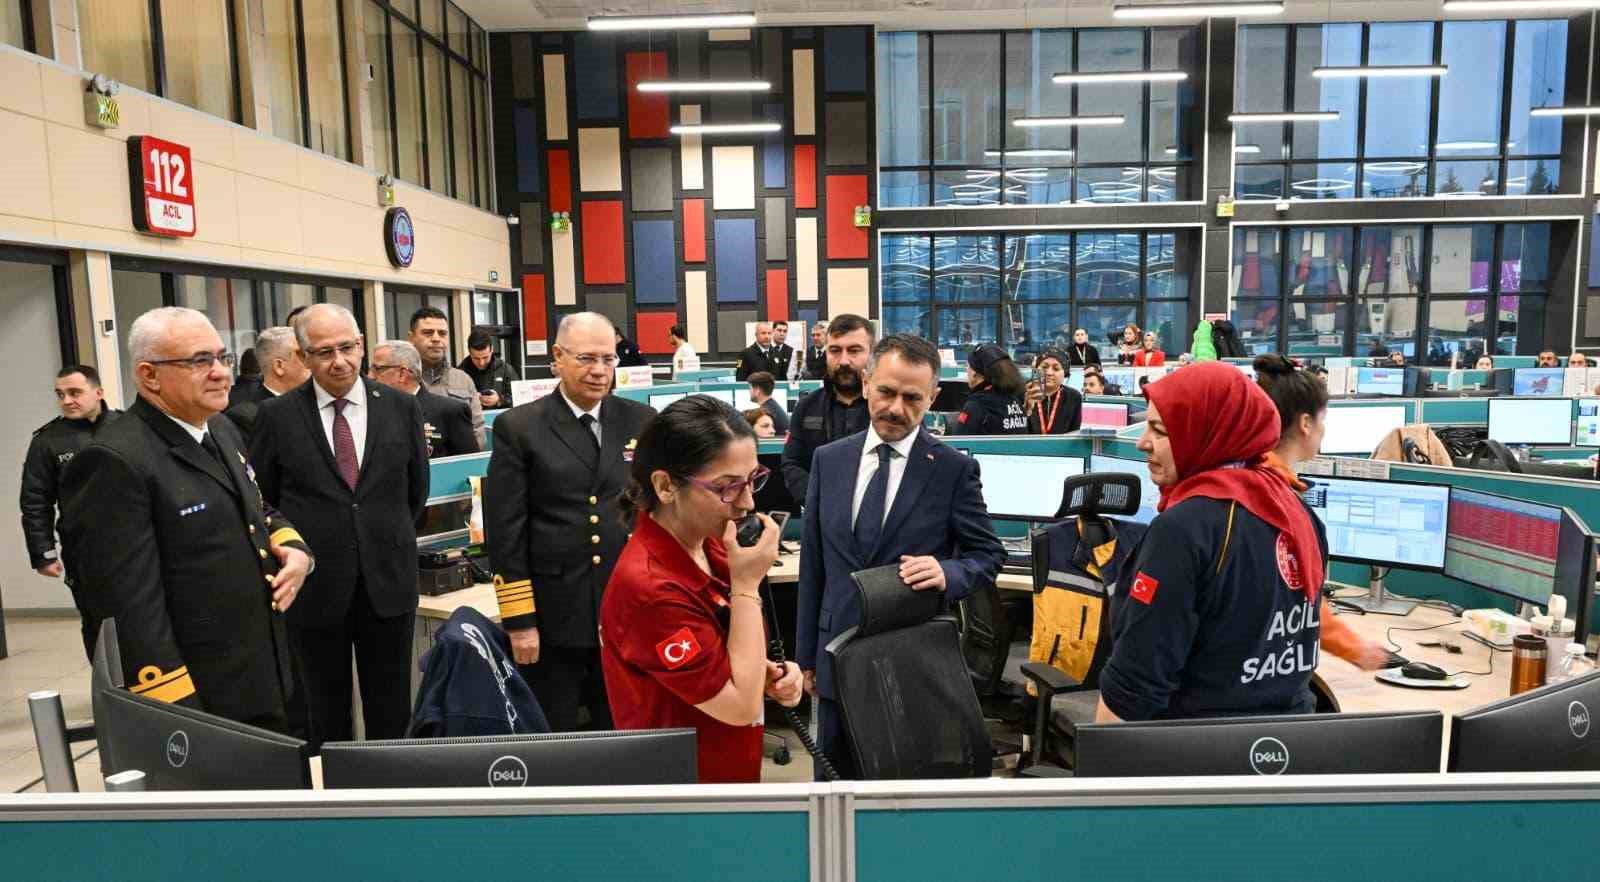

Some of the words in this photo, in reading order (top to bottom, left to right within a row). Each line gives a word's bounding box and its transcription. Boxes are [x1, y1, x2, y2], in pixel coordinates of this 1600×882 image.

[150, 148, 188, 198] 112
[1255, 751, 1286, 763] DELL
[493, 769, 524, 781] DELL
